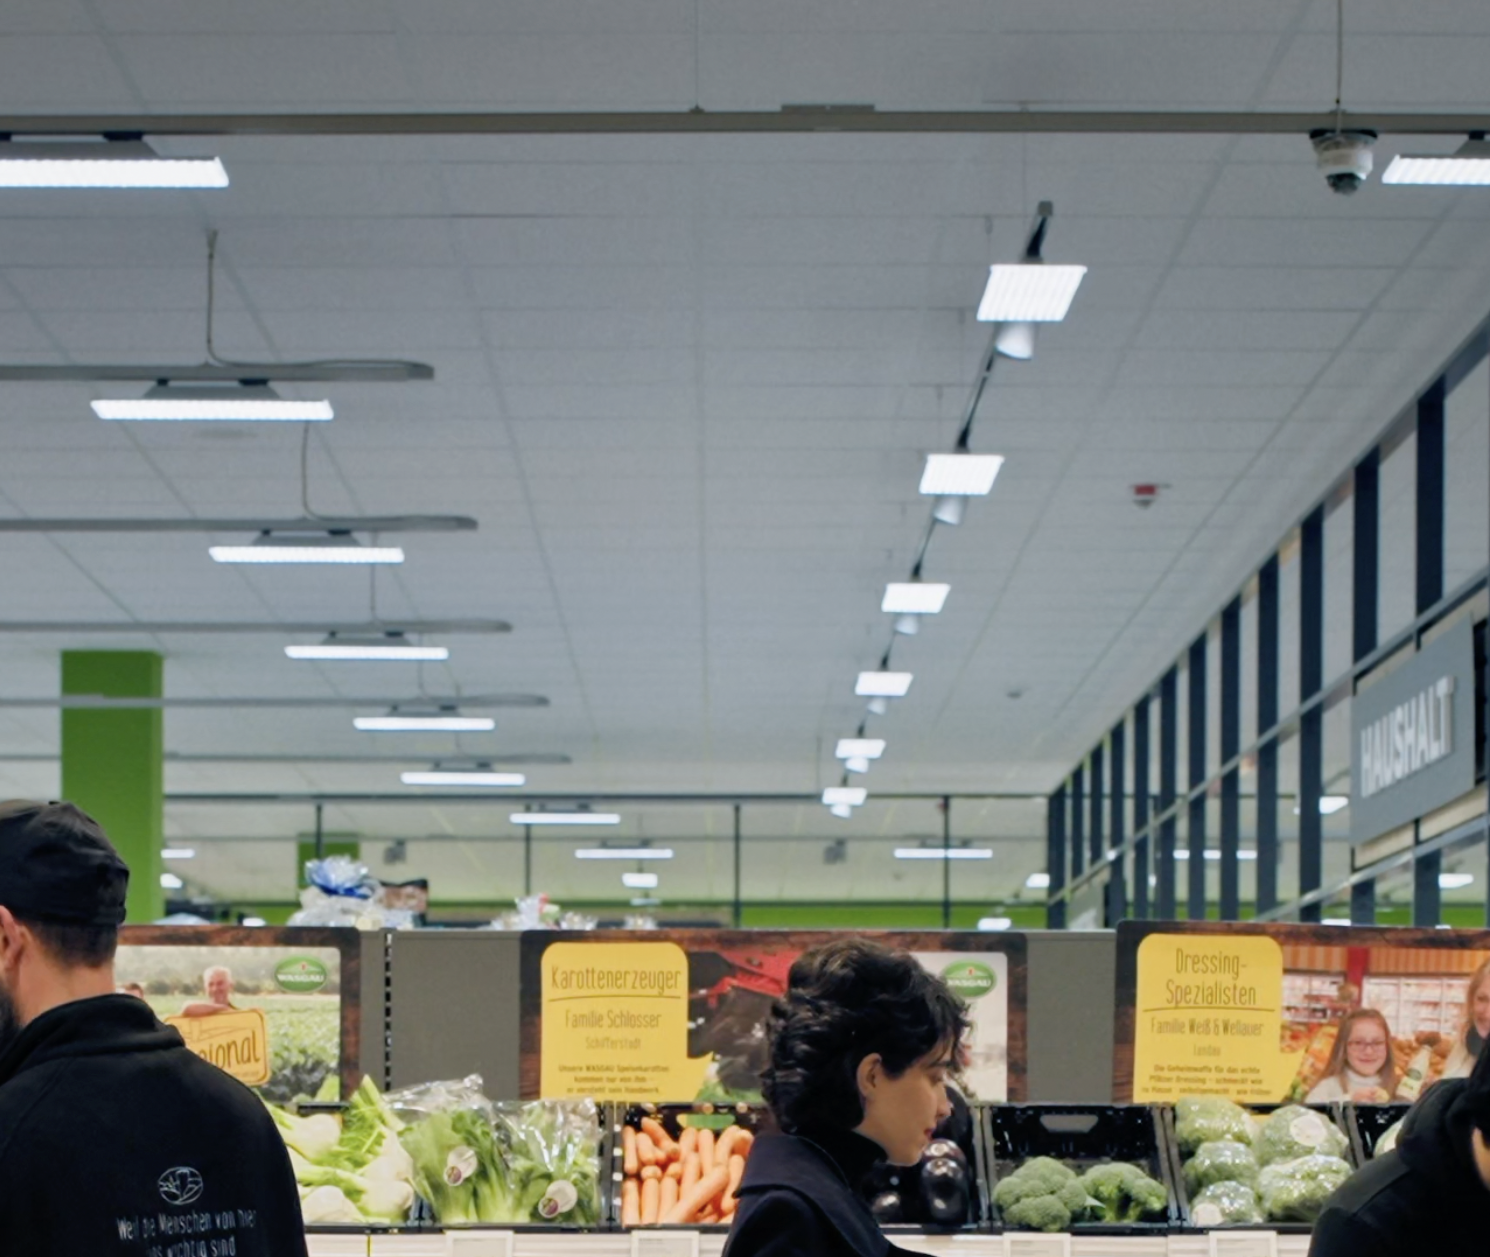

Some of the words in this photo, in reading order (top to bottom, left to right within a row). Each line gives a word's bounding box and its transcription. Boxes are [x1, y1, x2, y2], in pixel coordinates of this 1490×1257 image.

[1361, 674, 1457, 798] HAUSHALT
[1175, 947, 1248, 981] Dressing-
[551, 965, 681, 995] Karottenerzeuger
[1166, 979, 1256, 1008] Spezialisten
[565, 1008, 604, 1029] Familie
[607, 1008, 662, 1029] Schlosser
[1150, 1017, 1186, 1034] Familie
[210, 1235, 236, 1257] sind
